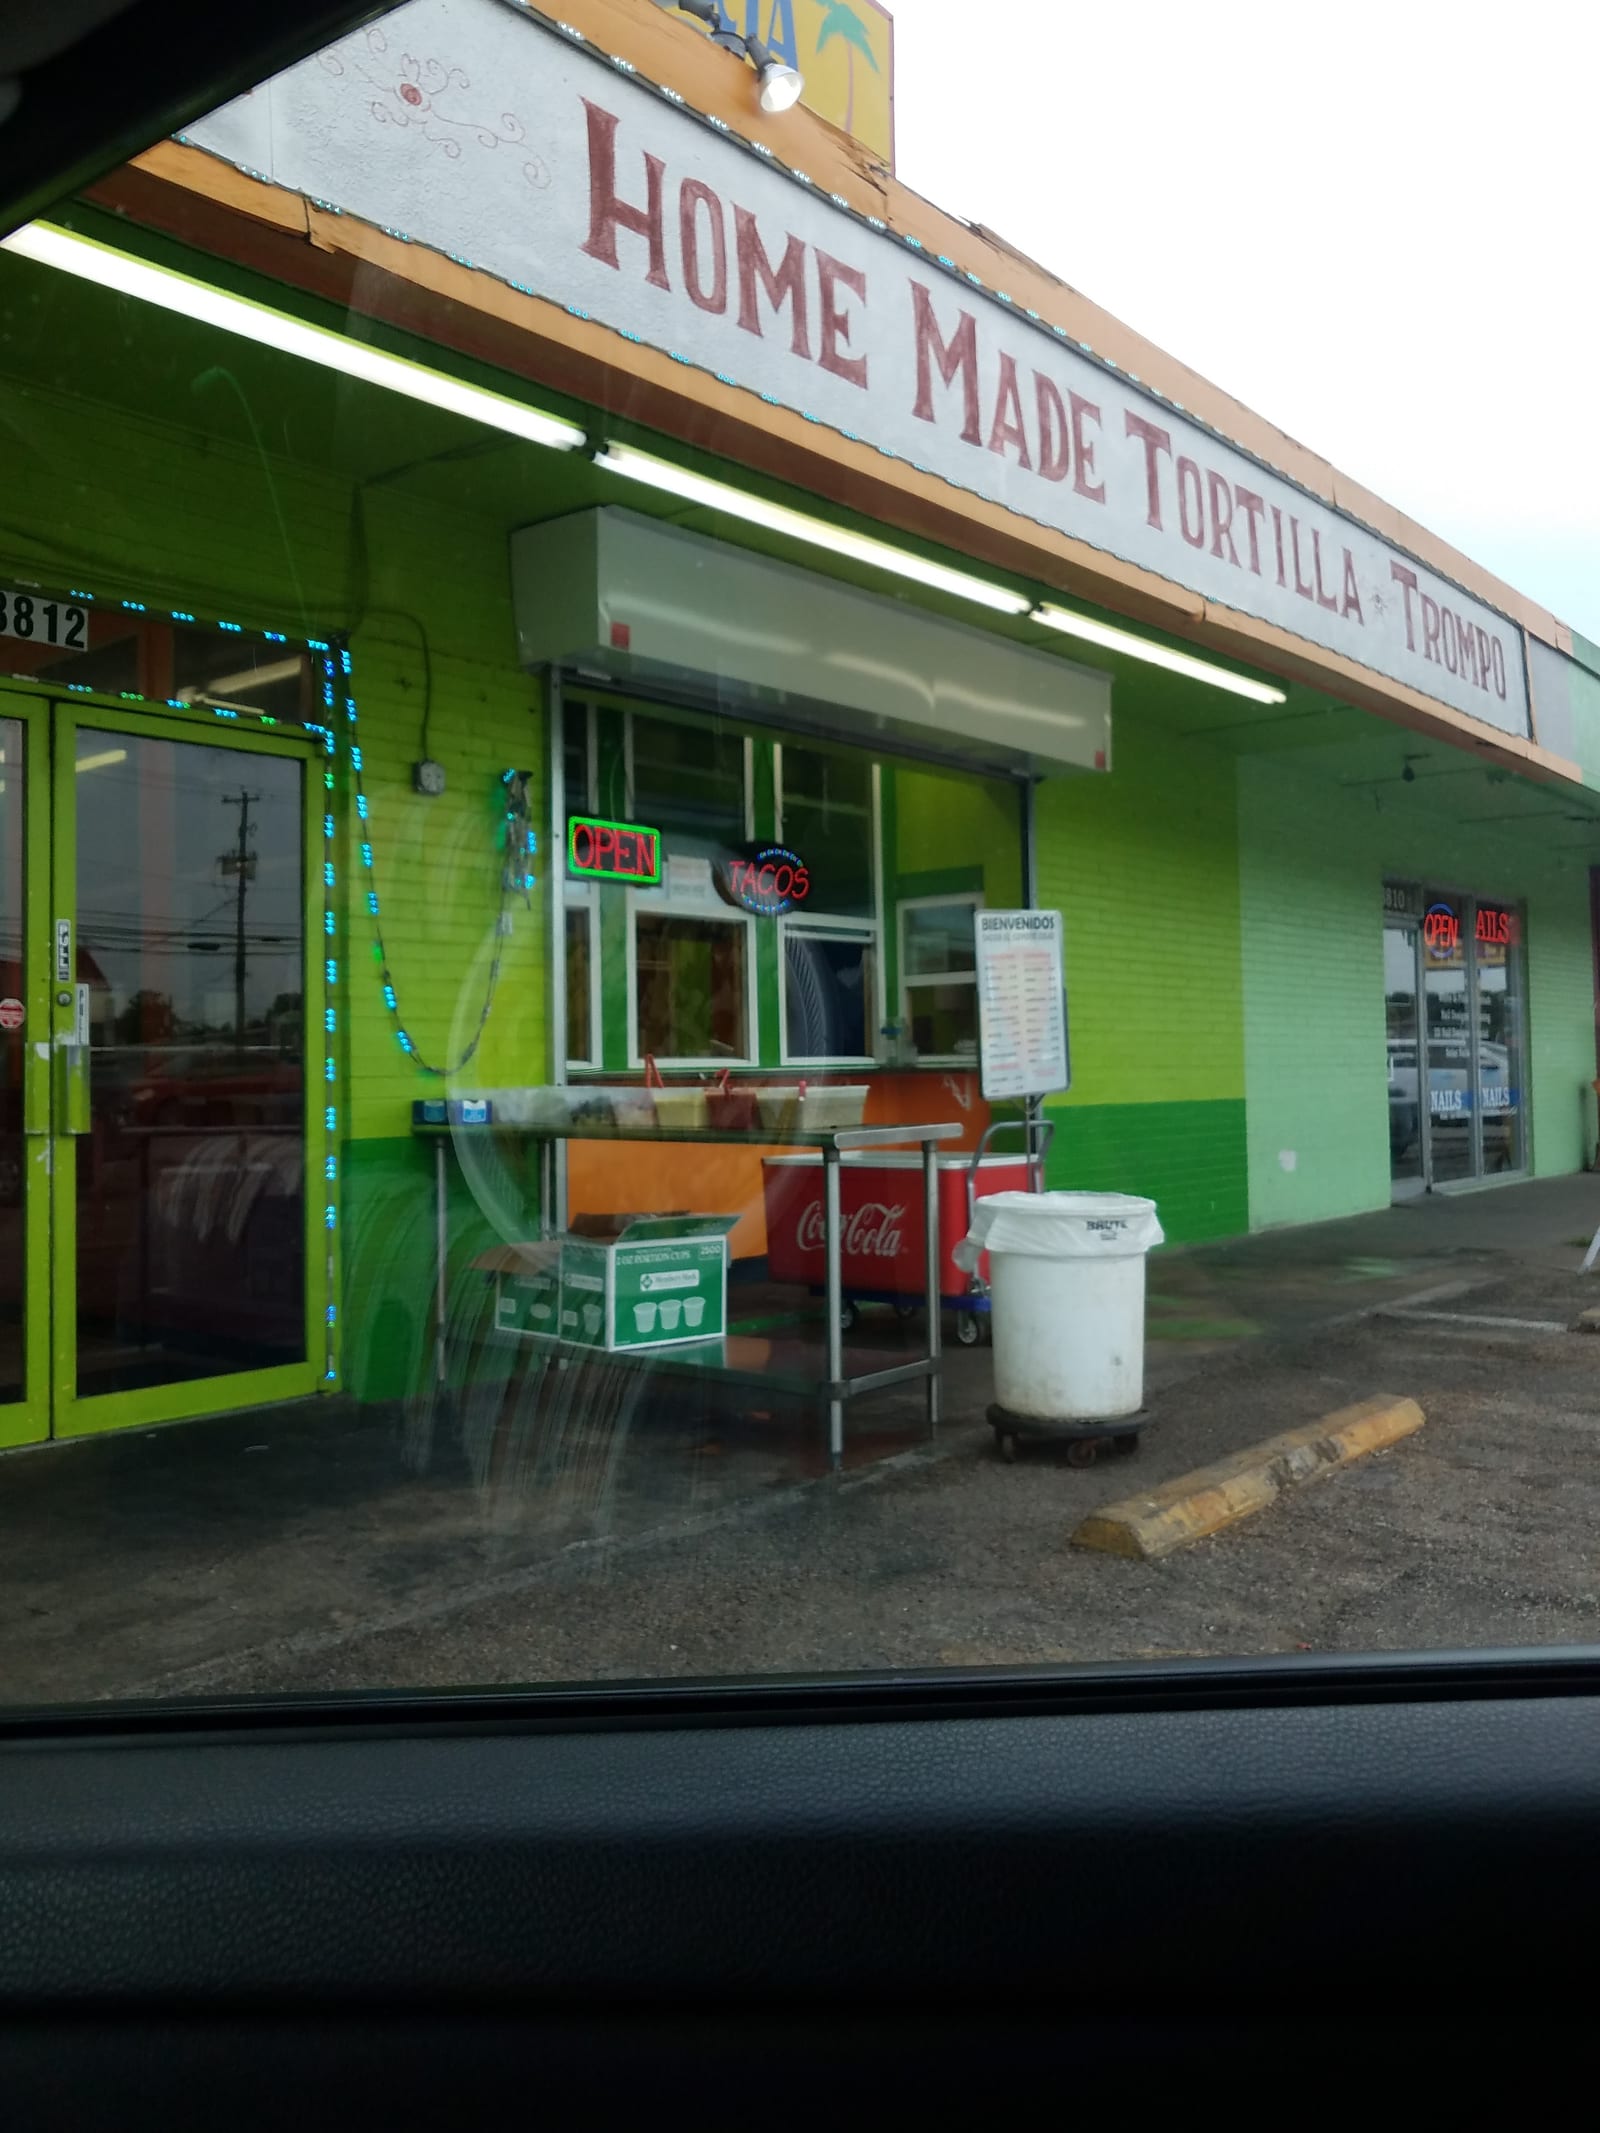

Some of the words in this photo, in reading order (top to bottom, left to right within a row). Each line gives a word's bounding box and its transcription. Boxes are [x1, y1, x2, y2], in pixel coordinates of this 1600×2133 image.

[579, 95, 868, 390] HOME
[908, 278, 1106, 505] MADE
[1124, 408, 1364, 626] TORTILLA
[1390, 559, 1506, 701] TROMPO
[574, 824, 657, 876] OPEN
[729, 859, 809, 899] TACOS
[982, 916, 1055, 930] BIENVENIDOS
[1424, 913, 1458, 948] OPEN
[1430, 1089, 1463, 1112] NAILS
[1482, 1087, 1510, 1107] NAILS
[797, 1200, 905, 1257] Co-Cola
